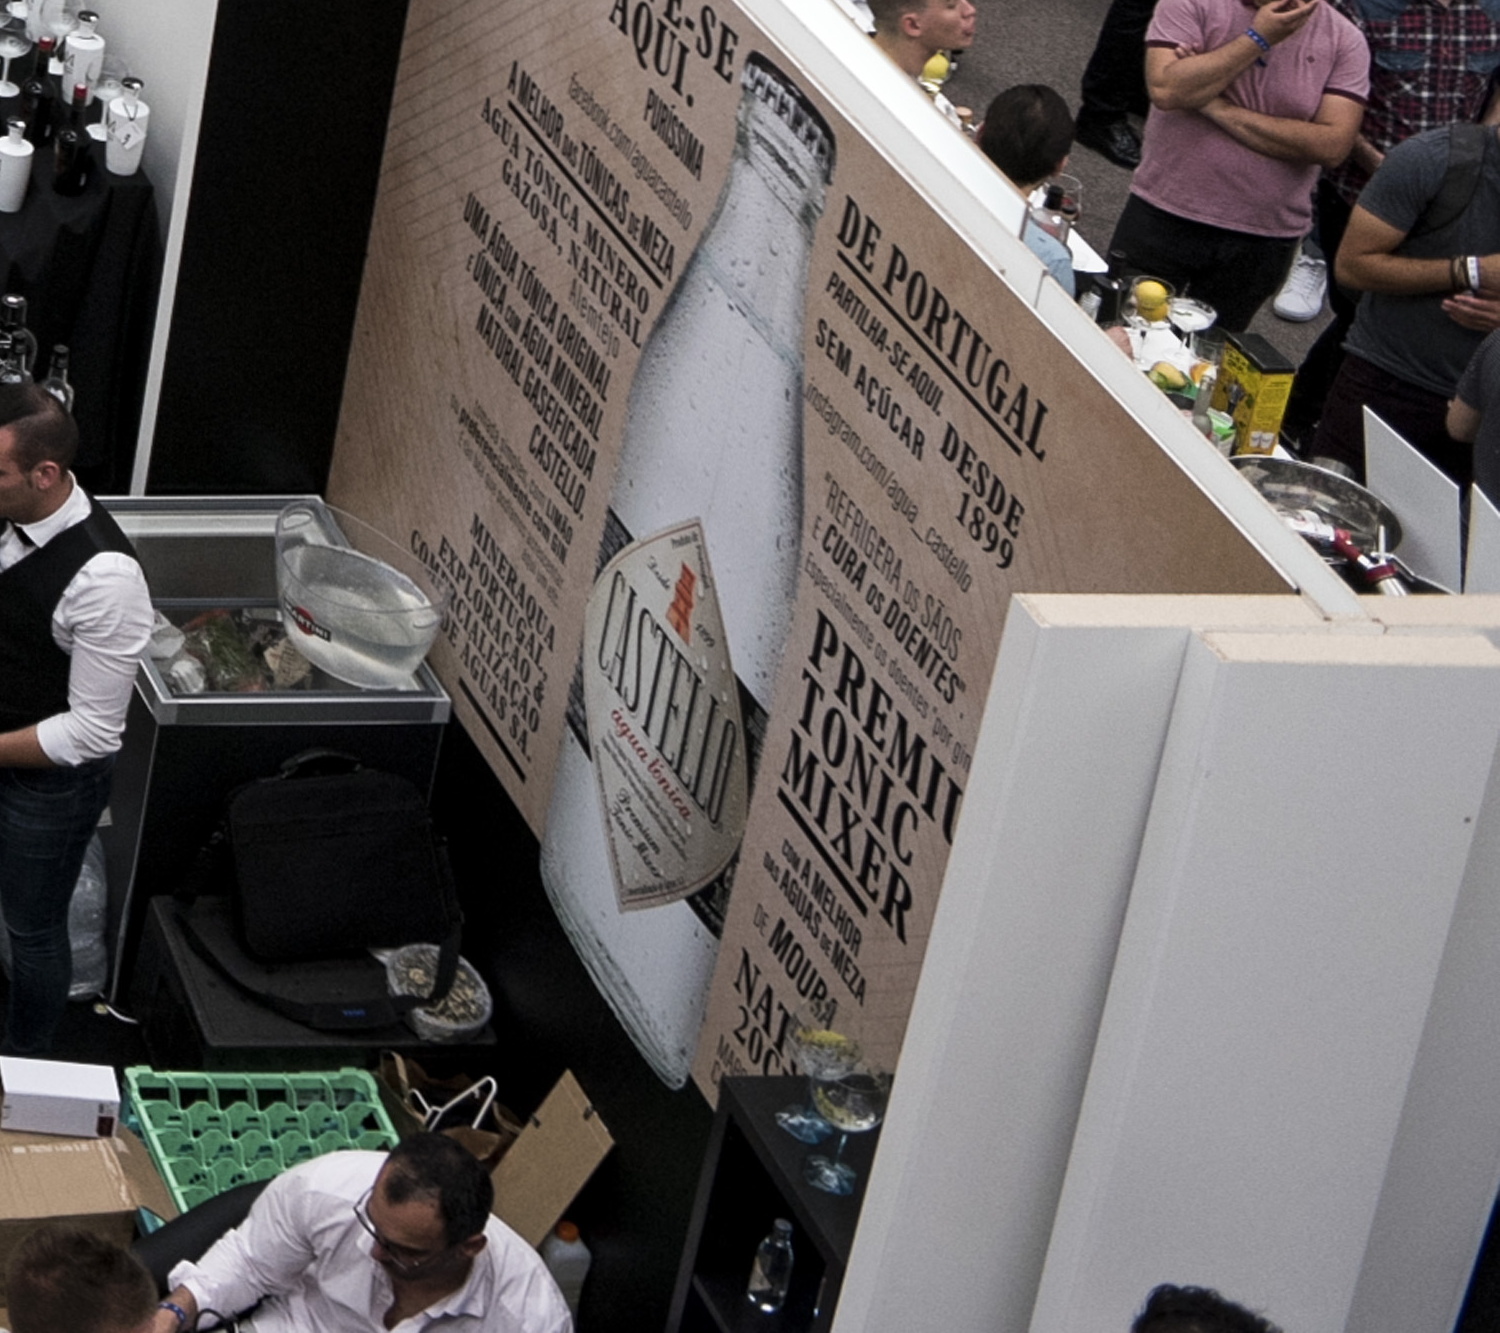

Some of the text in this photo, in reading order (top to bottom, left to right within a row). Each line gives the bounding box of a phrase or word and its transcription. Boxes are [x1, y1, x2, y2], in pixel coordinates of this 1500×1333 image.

[480, 96, 650, 315] AGUA TÓNICA MINERO
[507, 60, 675, 282] A MELHOR DAS TÓNICAS DE MEZA
[568, 71, 693, 231] facebook.com/aguacastello
[642, 87, 705, 182] PURÍSSIMA
[463, 191, 612, 403] UMA ÁGUA TÓNICA ORIGINAL
[502, 158, 643, 350] GAZOSA, NATURAL
[473, 249, 508, 316] ÚNICA
[504, 304, 522, 334] COM
[519, 311, 554, 376] ÁGUA
[550, 354, 605, 443] MINERAL
[476, 303, 525, 388] NATURAL
[522, 366, 597, 483] GASEIFICADA
[815, 318, 927, 461] SEM AÇÚCAR
[825, 271, 945, 416] PARTILHA-SE AQUI.
[837, 194, 1049, 463] DE PORTUGAL
[939, 420, 1026, 540] DESDE
[955, 492, 1015, 570] 1899
[284, 599, 329, 641] MARTINI
[437, 534, 532, 684] EXPLORAÇÃO
[468, 543, 548, 683] PORTUGAL,
[469, 511, 556, 654] MINERAQUA
[811, 515, 886, 616] E CURA OS
[902, 580, 921, 614] OS
[920, 593, 963, 663] SÃOS
[459, 642, 508, 722] AGUAS
[597, 568, 738, 827] CASTELLO
[887, 656, 929, 720] doentes
[781, 728, 913, 946] MIXER
[799, 667, 919, 867] TONIC
[752, 903, 771, 938] DE
[762, 851, 781, 884] DAS
[818, 931, 833, 958] DE
[829, 939, 867, 1008] MEZA
[781, 838, 864, 959] COM A MELHOR
[733, 946, 793, 1059] NAT
